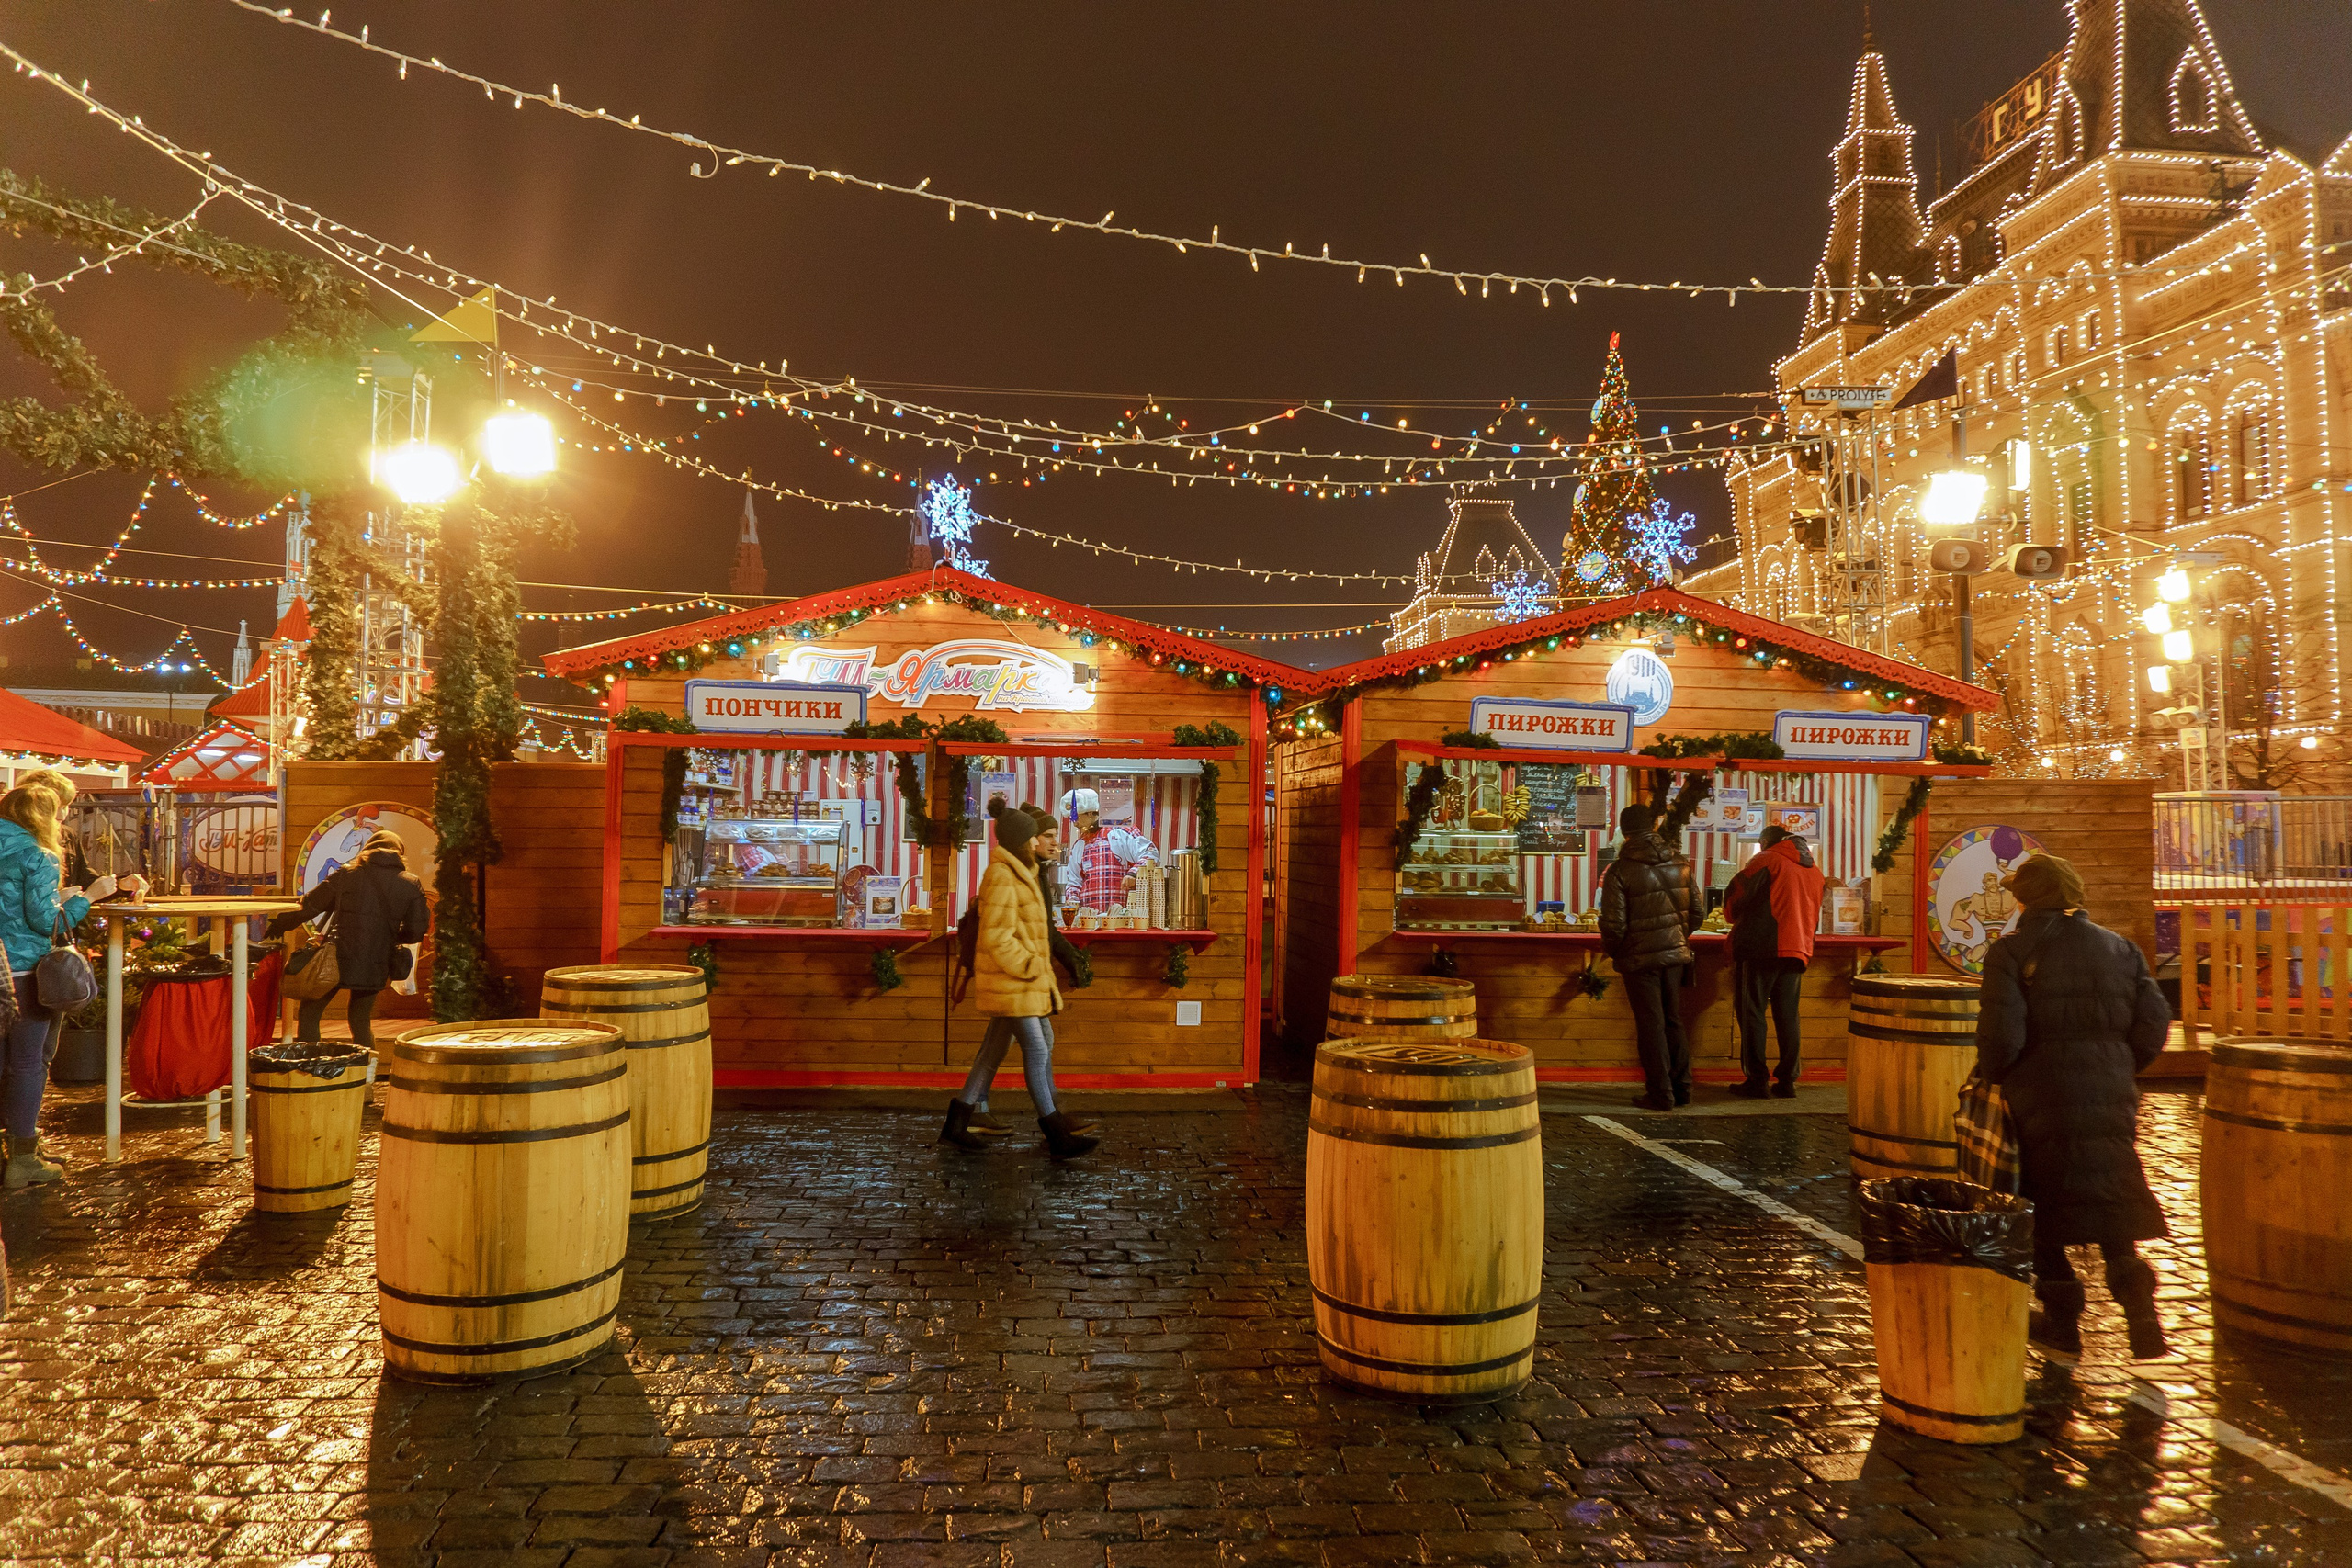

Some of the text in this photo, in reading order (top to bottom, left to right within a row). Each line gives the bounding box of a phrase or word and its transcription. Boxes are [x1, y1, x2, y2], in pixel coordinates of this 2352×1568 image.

[1830, 389, 1883, 400] PROLYTE
[705, 697, 842, 719] ПОНЧИКИ
[1637, 702, 1668, 723] ПЛОЩАДЬ
[1487, 713, 1616, 736] ПИРОЖКИ
[1790, 727, 1911, 746] ПИРОЖКИ
